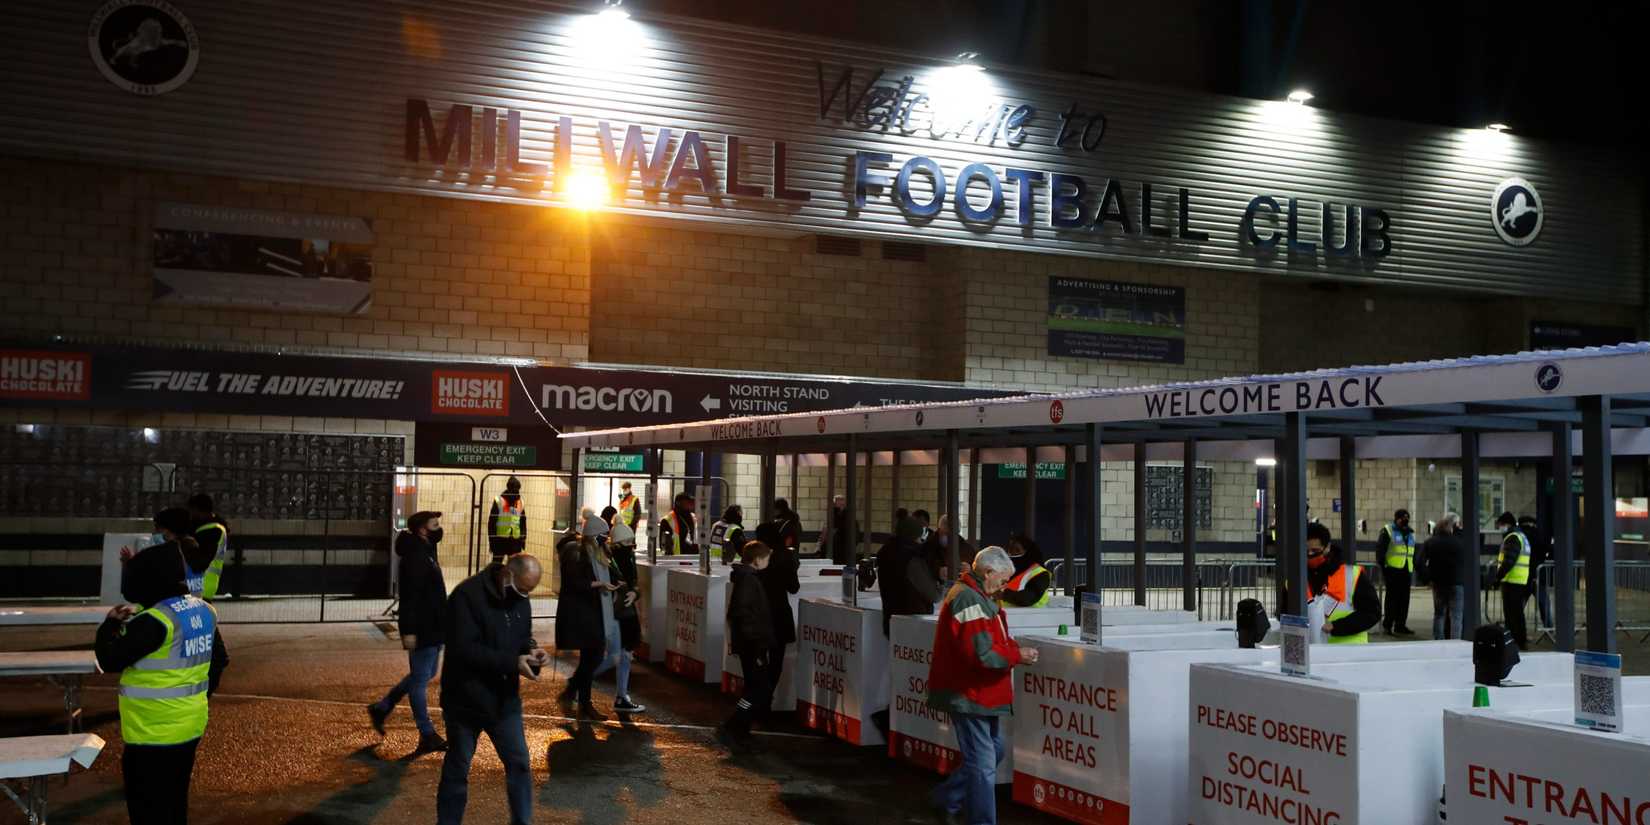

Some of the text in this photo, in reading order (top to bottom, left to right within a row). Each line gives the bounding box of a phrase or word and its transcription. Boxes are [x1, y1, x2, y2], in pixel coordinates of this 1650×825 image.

[819, 61, 1108, 153] Welcme to
[855, 151, 1210, 244] FOOTBALL
[1242, 195, 1393, 259] CLUB
[1056, 279, 1112, 291] ADVERTISING
[1122, 285, 1177, 297] SPONSORSHIP
[0, 357, 84, 382] HUSKI
[0, 379, 83, 393] CHOCOLATE
[135, 370, 404, 400] FUEL THE ADVENTURE!
[438, 377, 504, 399] HUSKI
[730, 384, 830, 400] NORTH STAND
[438, 397, 504, 410] CHOCOLATE
[542, 384, 673, 414] macron
[729, 399, 789, 413] VISITING
[1144, 376, 1384, 418] WELCOME BACK
[480, 429, 500, 440] W3
[711, 419, 784, 440] WELCOME BACK
[446, 444, 527, 455] EMERGENCY EXIT
[457, 454, 515, 464] KEEP CLEAR
[1013, 469, 1028, 479] KEE
[1050, 463, 1065, 471] EXIT
[185, 633, 212, 656] WISE
[803, 624, 856, 654] ENTRANCE
[812, 648, 848, 673] TO ALL
[894, 644, 925, 664] PLEASE
[814, 671, 844, 695] AREAS
[1023, 672, 1118, 712] ENTRANCE
[1039, 703, 1100, 739] TO ALL
[1197, 704, 1348, 757] PLEASE OBSERVE
[1042, 734, 1097, 769] AREAS
[1227, 751, 1310, 795] SOCIAL
